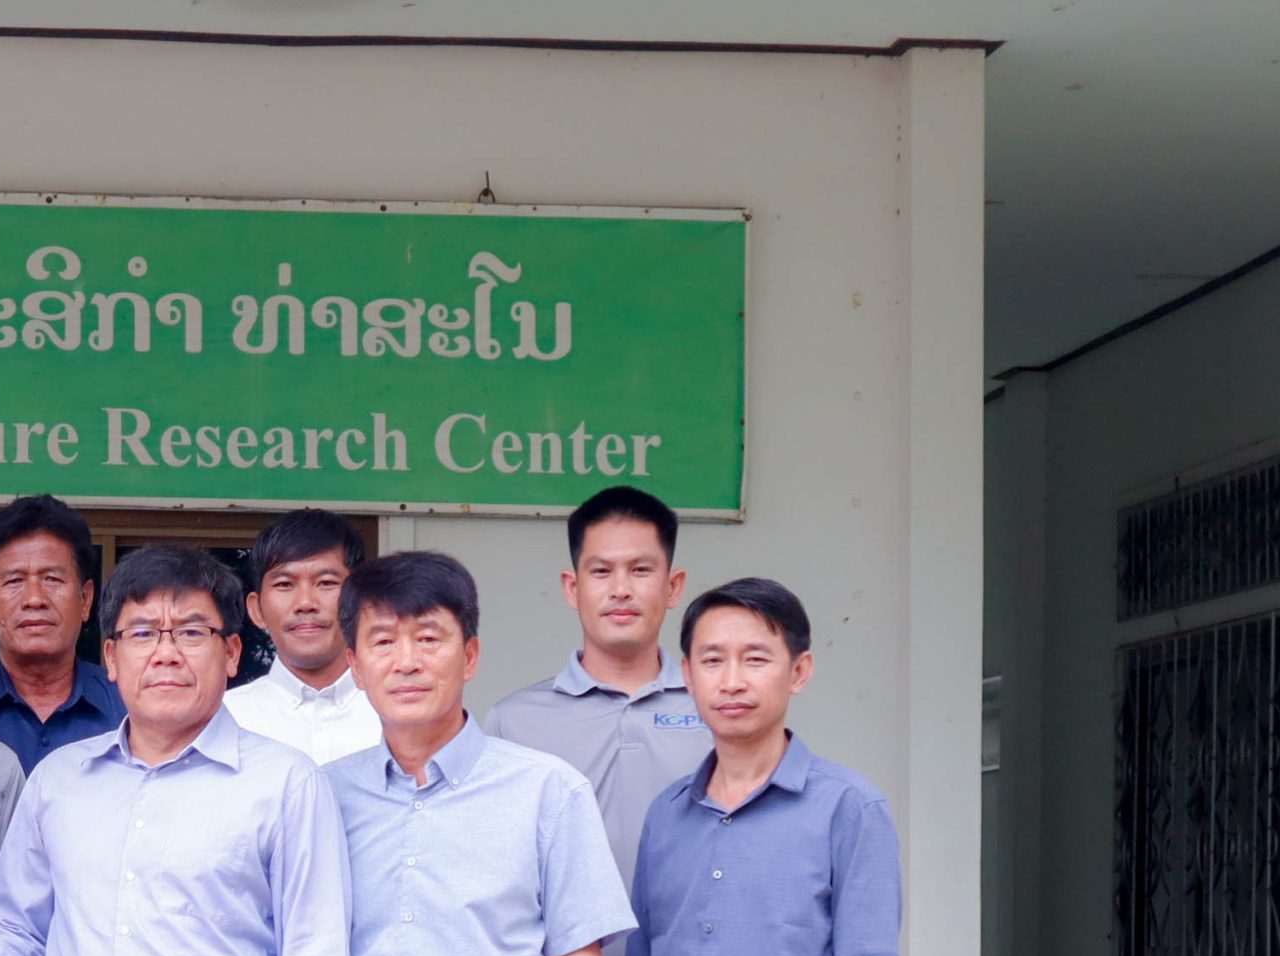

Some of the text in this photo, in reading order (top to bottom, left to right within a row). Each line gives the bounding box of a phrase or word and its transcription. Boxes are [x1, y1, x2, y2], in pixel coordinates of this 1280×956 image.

[231, 251, 573, 361] ທ່າສະໂນ
[101, 407, 410, 471] Research
[434, 413, 661, 476] Center
[654, 713, 705, 726] KOPI
